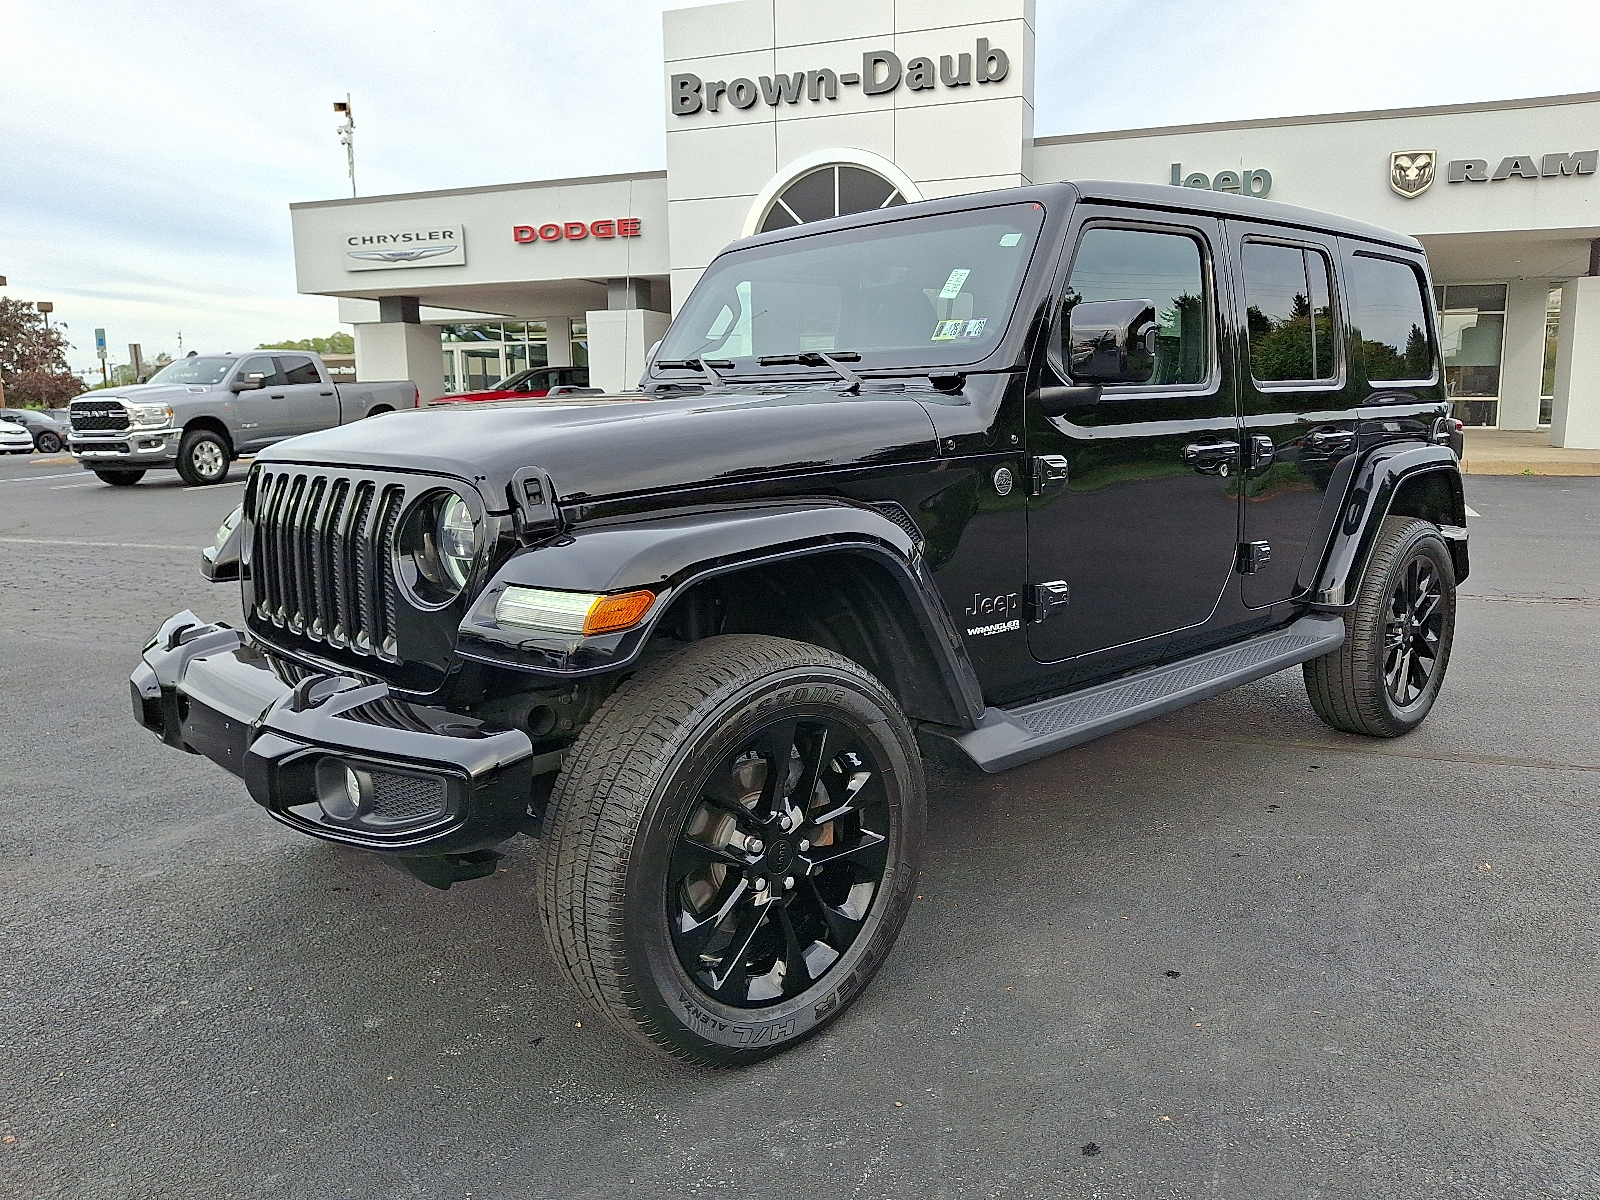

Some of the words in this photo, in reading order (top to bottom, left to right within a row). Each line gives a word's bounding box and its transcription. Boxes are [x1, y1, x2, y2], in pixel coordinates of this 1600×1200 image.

[670, 37, 1010, 116] Brown-Daub
[1447, 150, 1599, 184] RAM
[347, 230, 454, 246] CHRYSLER
[512, 217, 642, 244] DODGE
[965, 592, 1018, 618] Jeep
[967, 620, 1019, 635] WRANGLER
